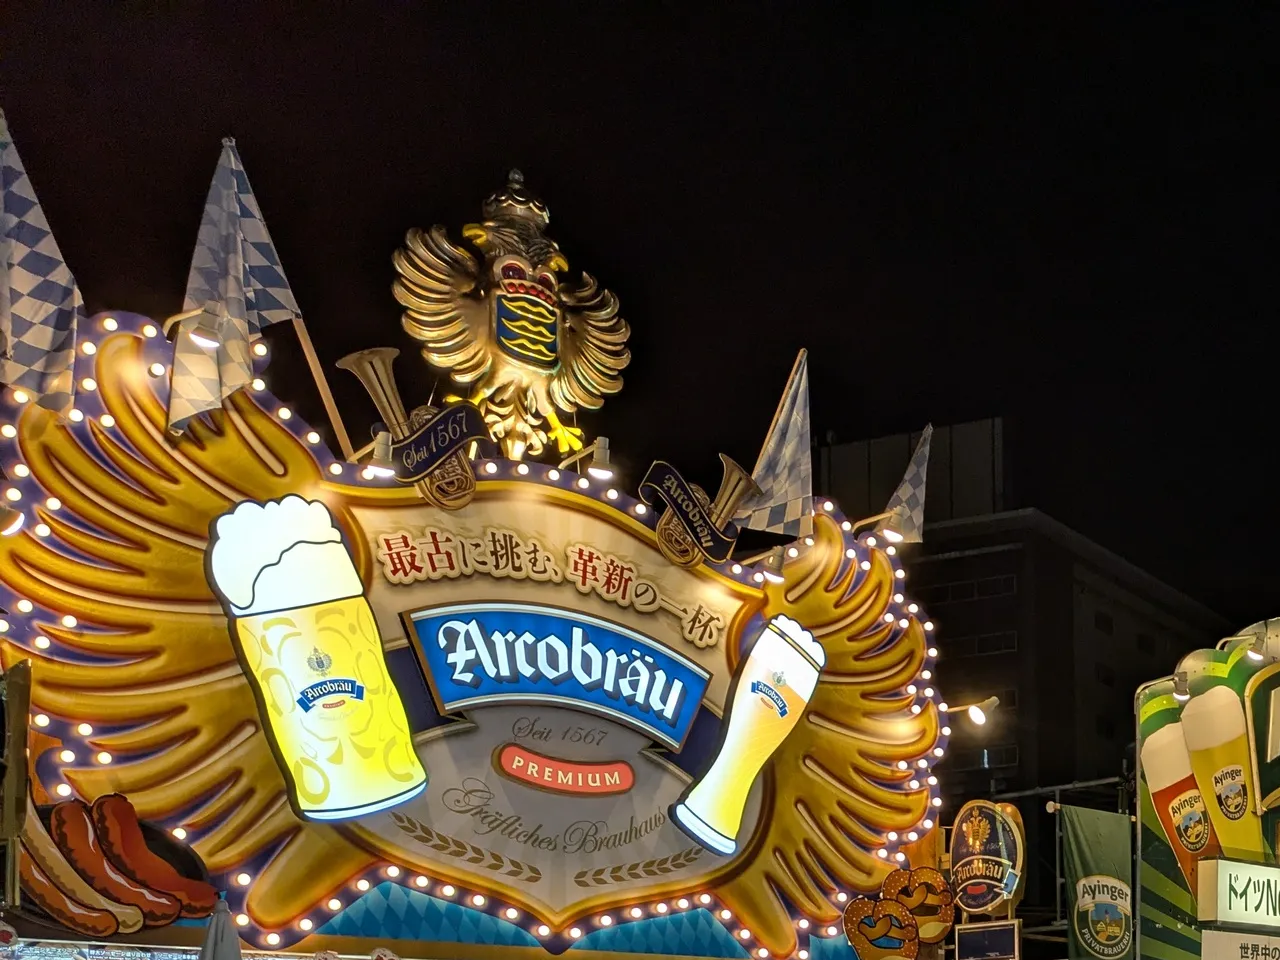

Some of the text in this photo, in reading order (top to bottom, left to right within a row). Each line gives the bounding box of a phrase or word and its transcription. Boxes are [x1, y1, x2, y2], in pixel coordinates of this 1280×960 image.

[427, 412, 468, 455] 1567
[663, 474, 715, 549] Arcobräu
[438, 618, 685, 721] Arcobräu
[305, 681, 352, 700] Arcobräu
[756, 681, 786, 713] Arcobräu
[512, 717, 607, 747] Seit 1567
[512, 756, 622, 788] PREMIUM
[1214, 769, 1242, 787] Ayinger
[1171, 795, 1201, 818] Ayinger
[563, 805, 667, 854] Brauhaus
[956, 860, 1003, 883] Arcobräu
[1081, 880, 1130, 902] Ayinger
